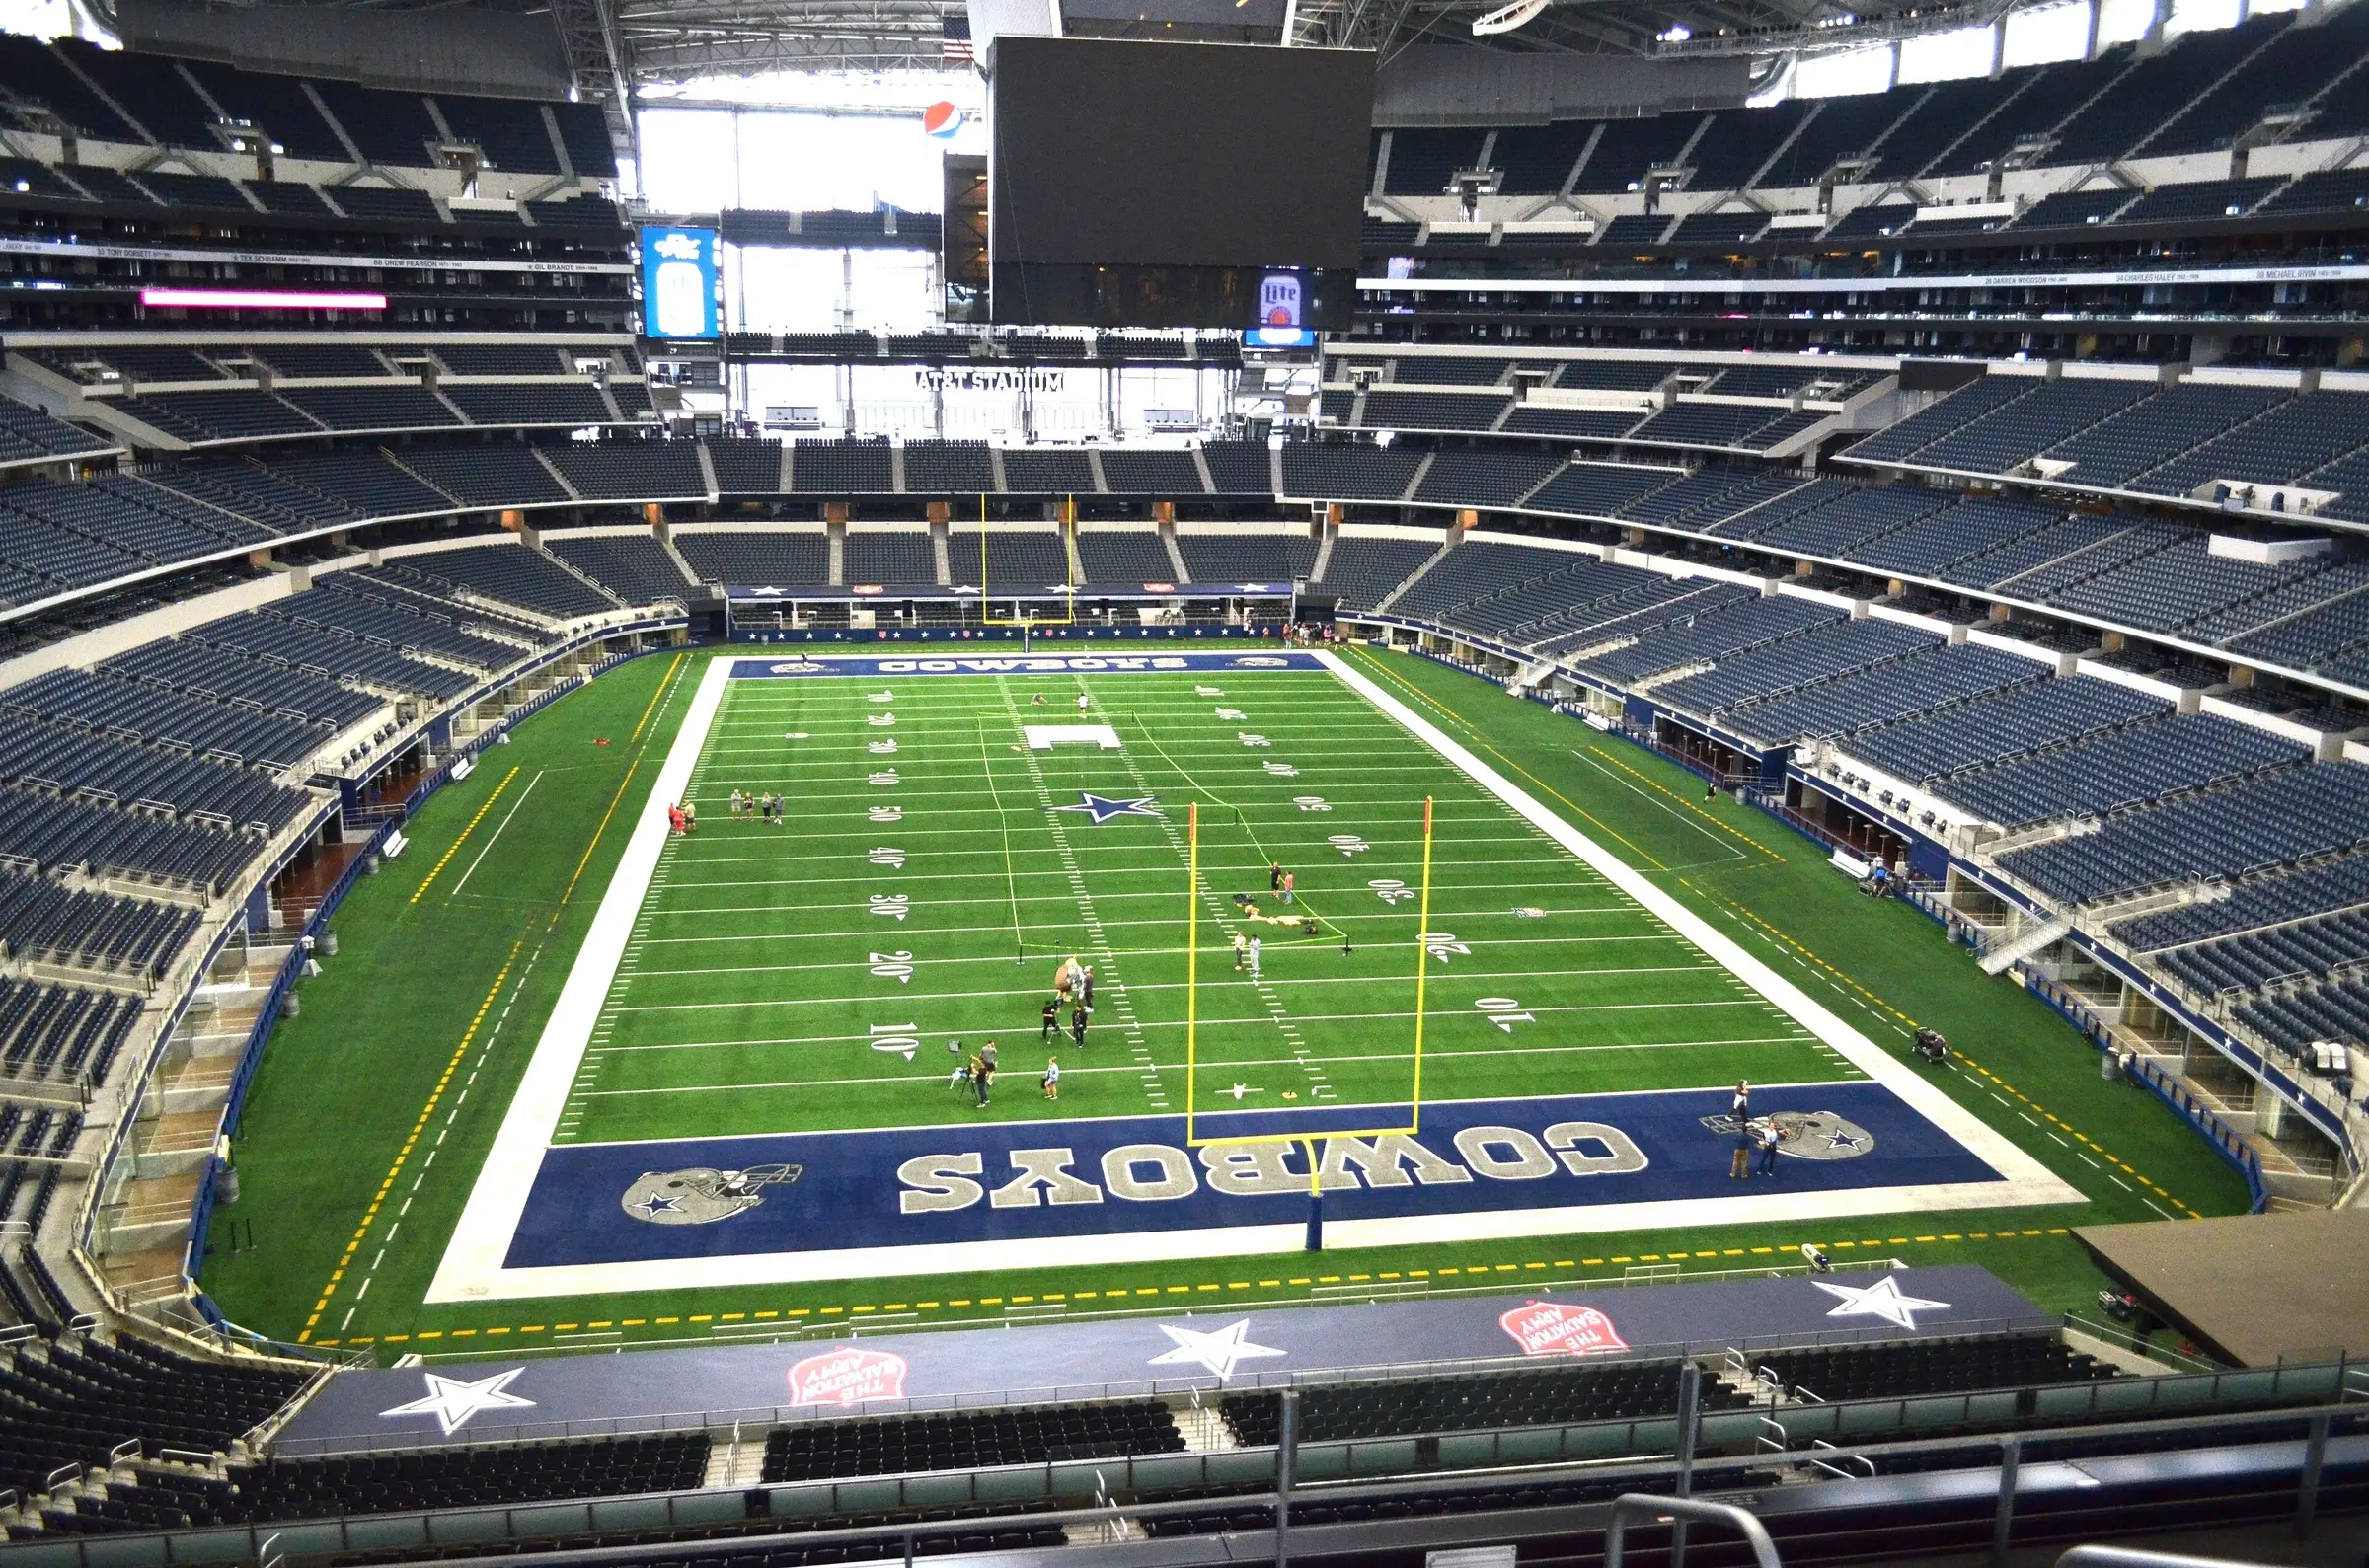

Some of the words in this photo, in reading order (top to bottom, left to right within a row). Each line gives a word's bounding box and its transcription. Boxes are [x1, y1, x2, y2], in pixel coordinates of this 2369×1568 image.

[1265, 284, 1296, 304] Lite
[917, 371, 968, 392] AT&T
[971, 372, 1065, 392] STADIUM
[878, 657, 1188, 672] COWBOYS
[869, 772, 900, 784] 40
[1263, 763, 1300, 777] 40
[869, 805, 902, 821] 50
[1292, 796, 1333, 811] 50
[1327, 835, 1370, 851] 40
[869, 847, 906, 864] 40
[1368, 879, 1415, 899] 30
[869, 894, 909, 915] 30
[1415, 932, 1472, 956] 20
[869, 950, 914, 976] 20
[1474, 997, 1536, 1024] 10
[869, 1021, 919, 1051] 10
[898, 1122, 1649, 1215] COWBOYS
[1520, 1307, 1563, 1334] ARMY
[1525, 1310, 1602, 1350] SALVATION
[1565, 1329, 1602, 1349] THE
[805, 1353, 865, 1384] ARMY
[802, 1358, 899, 1401] SALVATION
[840, 1379, 884, 1401] THE
